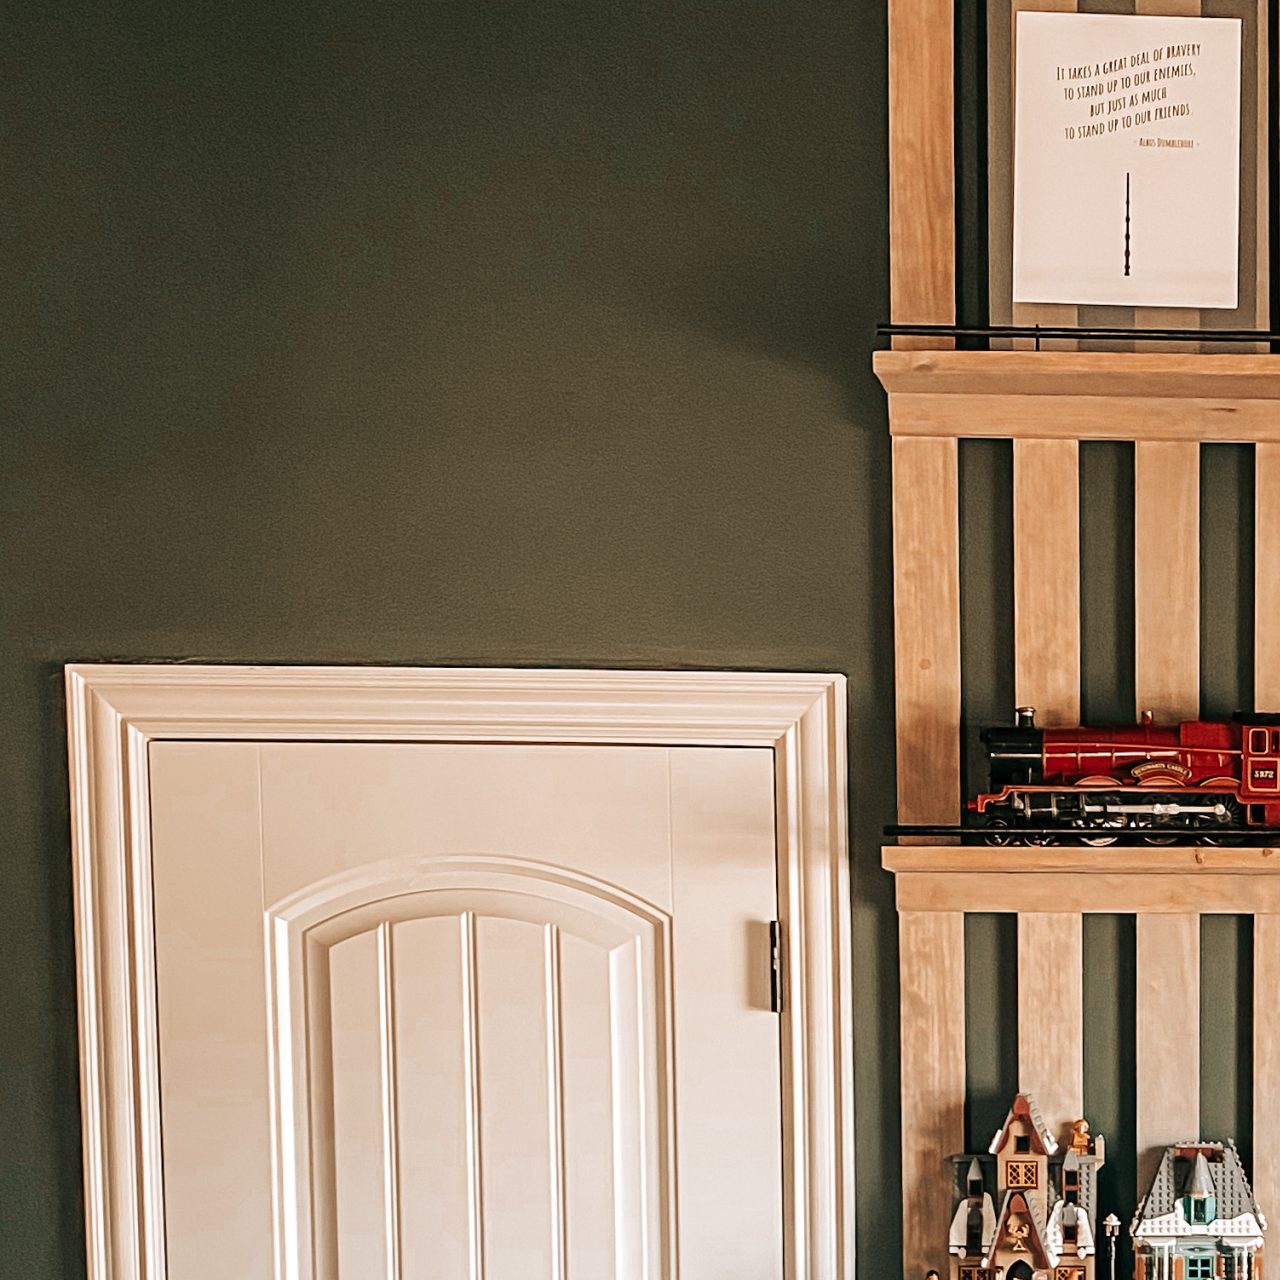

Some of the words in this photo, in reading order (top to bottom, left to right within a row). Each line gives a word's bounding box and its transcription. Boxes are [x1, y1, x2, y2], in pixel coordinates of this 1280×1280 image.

[1068, 65, 1091, 80] TAKES
[1094, 63, 1100, 76] A
[1103, 57, 1127, 75] GREAT
[1130, 51, 1150, 68] DEAL
[1153, 48, 1163, 62] OF
[1166, 43, 1201, 59] BRAVERY
[1064, 87, 1074, 101] TO
[1076, 83, 1104, 99] STAND
[1107, 79, 1118, 94] UP
[1121, 76, 1131, 90] TO
[1134, 70, 1151, 87] OUR
[1090, 102, 1105, 118] BUT
[1107, 96, 1127, 116] JUST
[1129, 93, 1139, 108] AS
[1141, 86, 1167, 105] MUCH
[1065, 126, 1075, 141] TO
[1077, 122, 1105, 139] STAND
[1107, 118, 1119, 133] UP
[1122, 115, 1132, 129] TO
[1134, 109, 1152, 126] OUR
